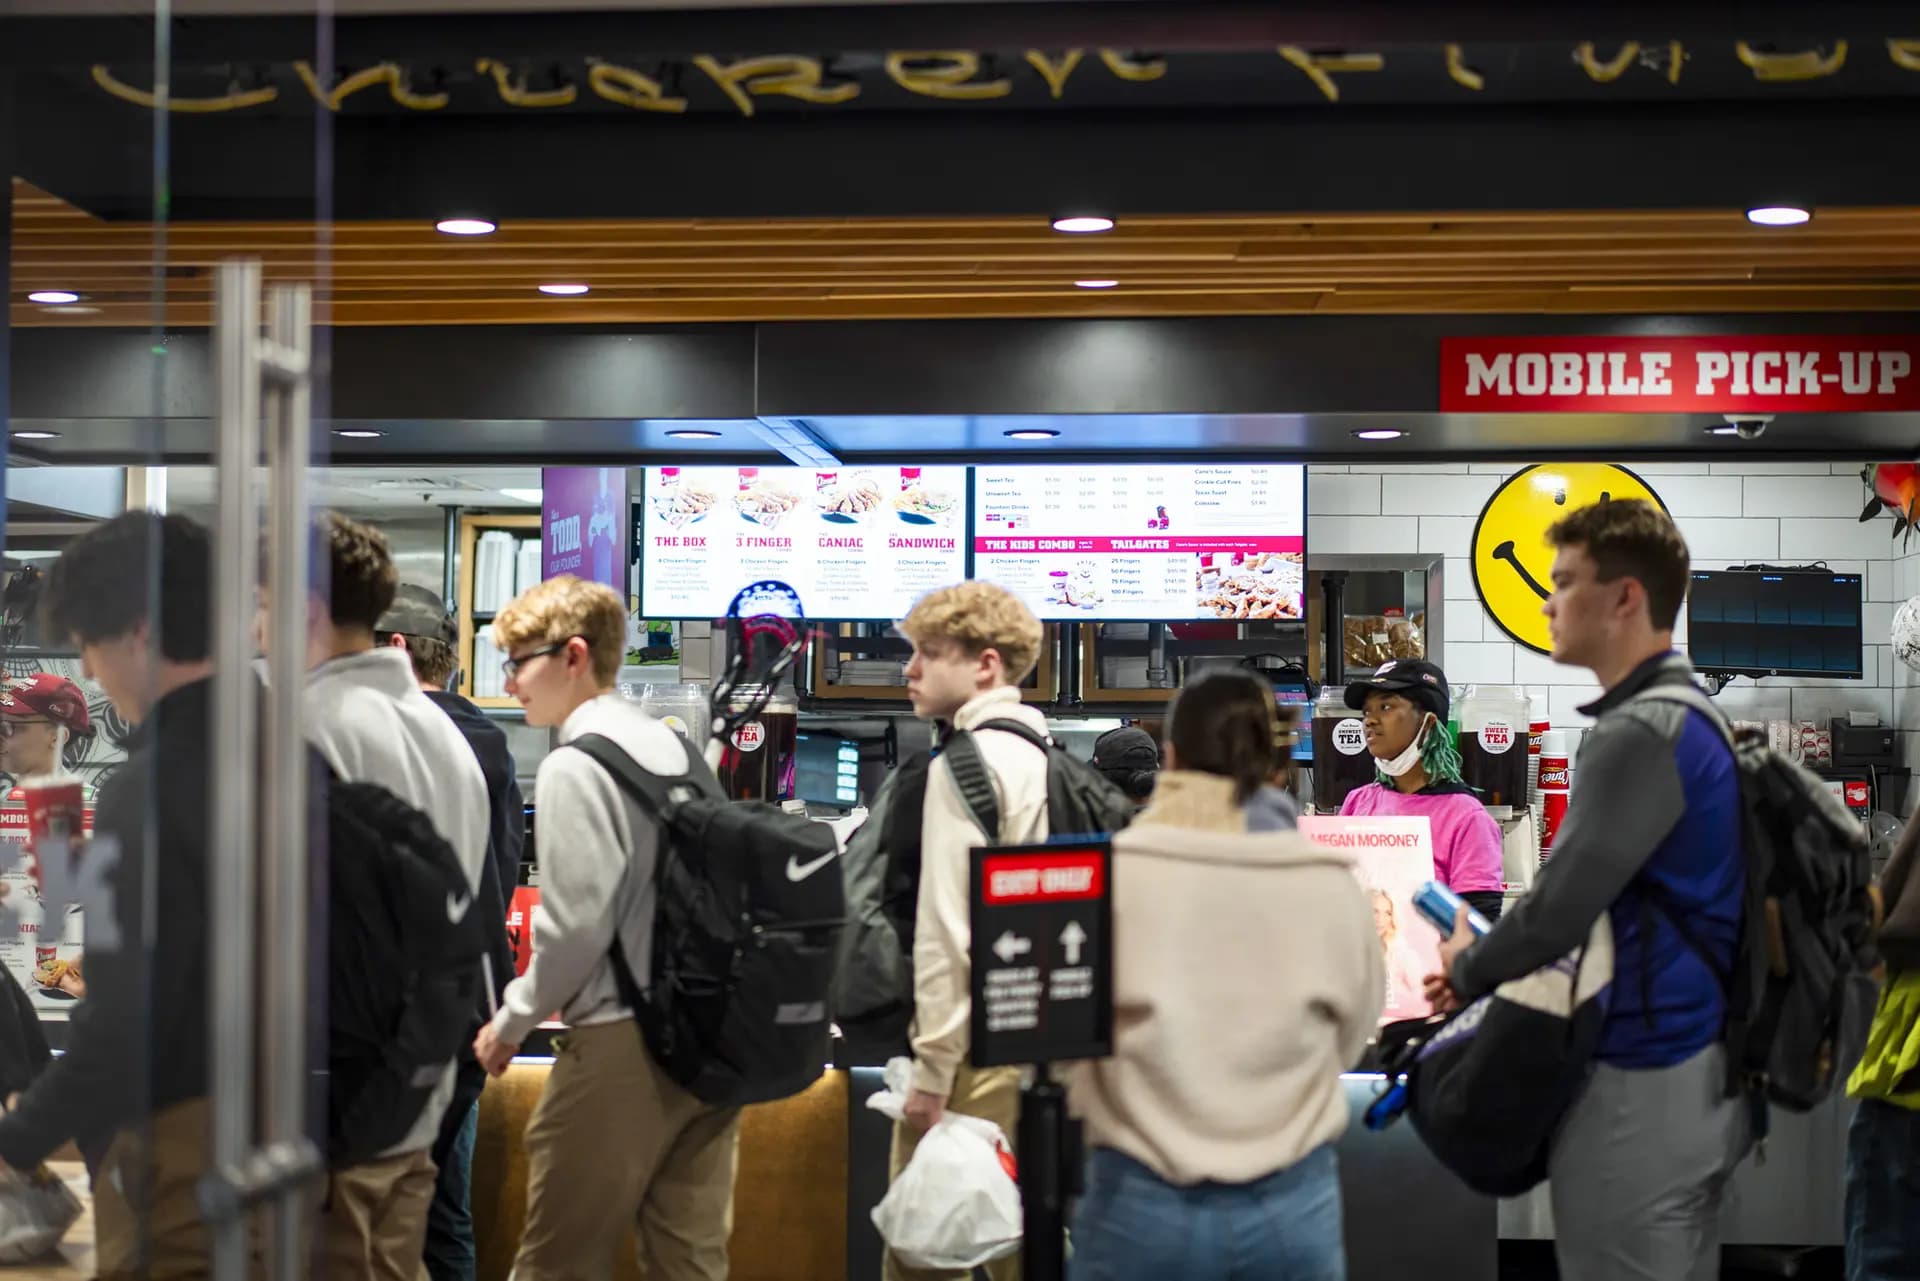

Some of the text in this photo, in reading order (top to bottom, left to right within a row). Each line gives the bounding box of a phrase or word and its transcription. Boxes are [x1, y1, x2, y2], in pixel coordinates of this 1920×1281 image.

[1465, 352, 1911, 396] MOBILE PICK-UP
[655, 537, 706, 546] THE BOX
[736, 538, 792, 547] 3 FINGER
[818, 538, 864, 548] CANIAC
[889, 538, 955, 548] SANDWICH
[985, 541, 1007, 550] THE
[1010, 541, 1035, 550] KIDS
[1038, 541, 1076, 550] COMBO
[1111, 540, 1169, 550] TAILGATES
[736, 732, 758, 743] TEA
[1338, 735, 1362, 745] TEA
[1485, 734, 1509, 744] TEA
[1358, 833, 1419, 848] MORONEY
